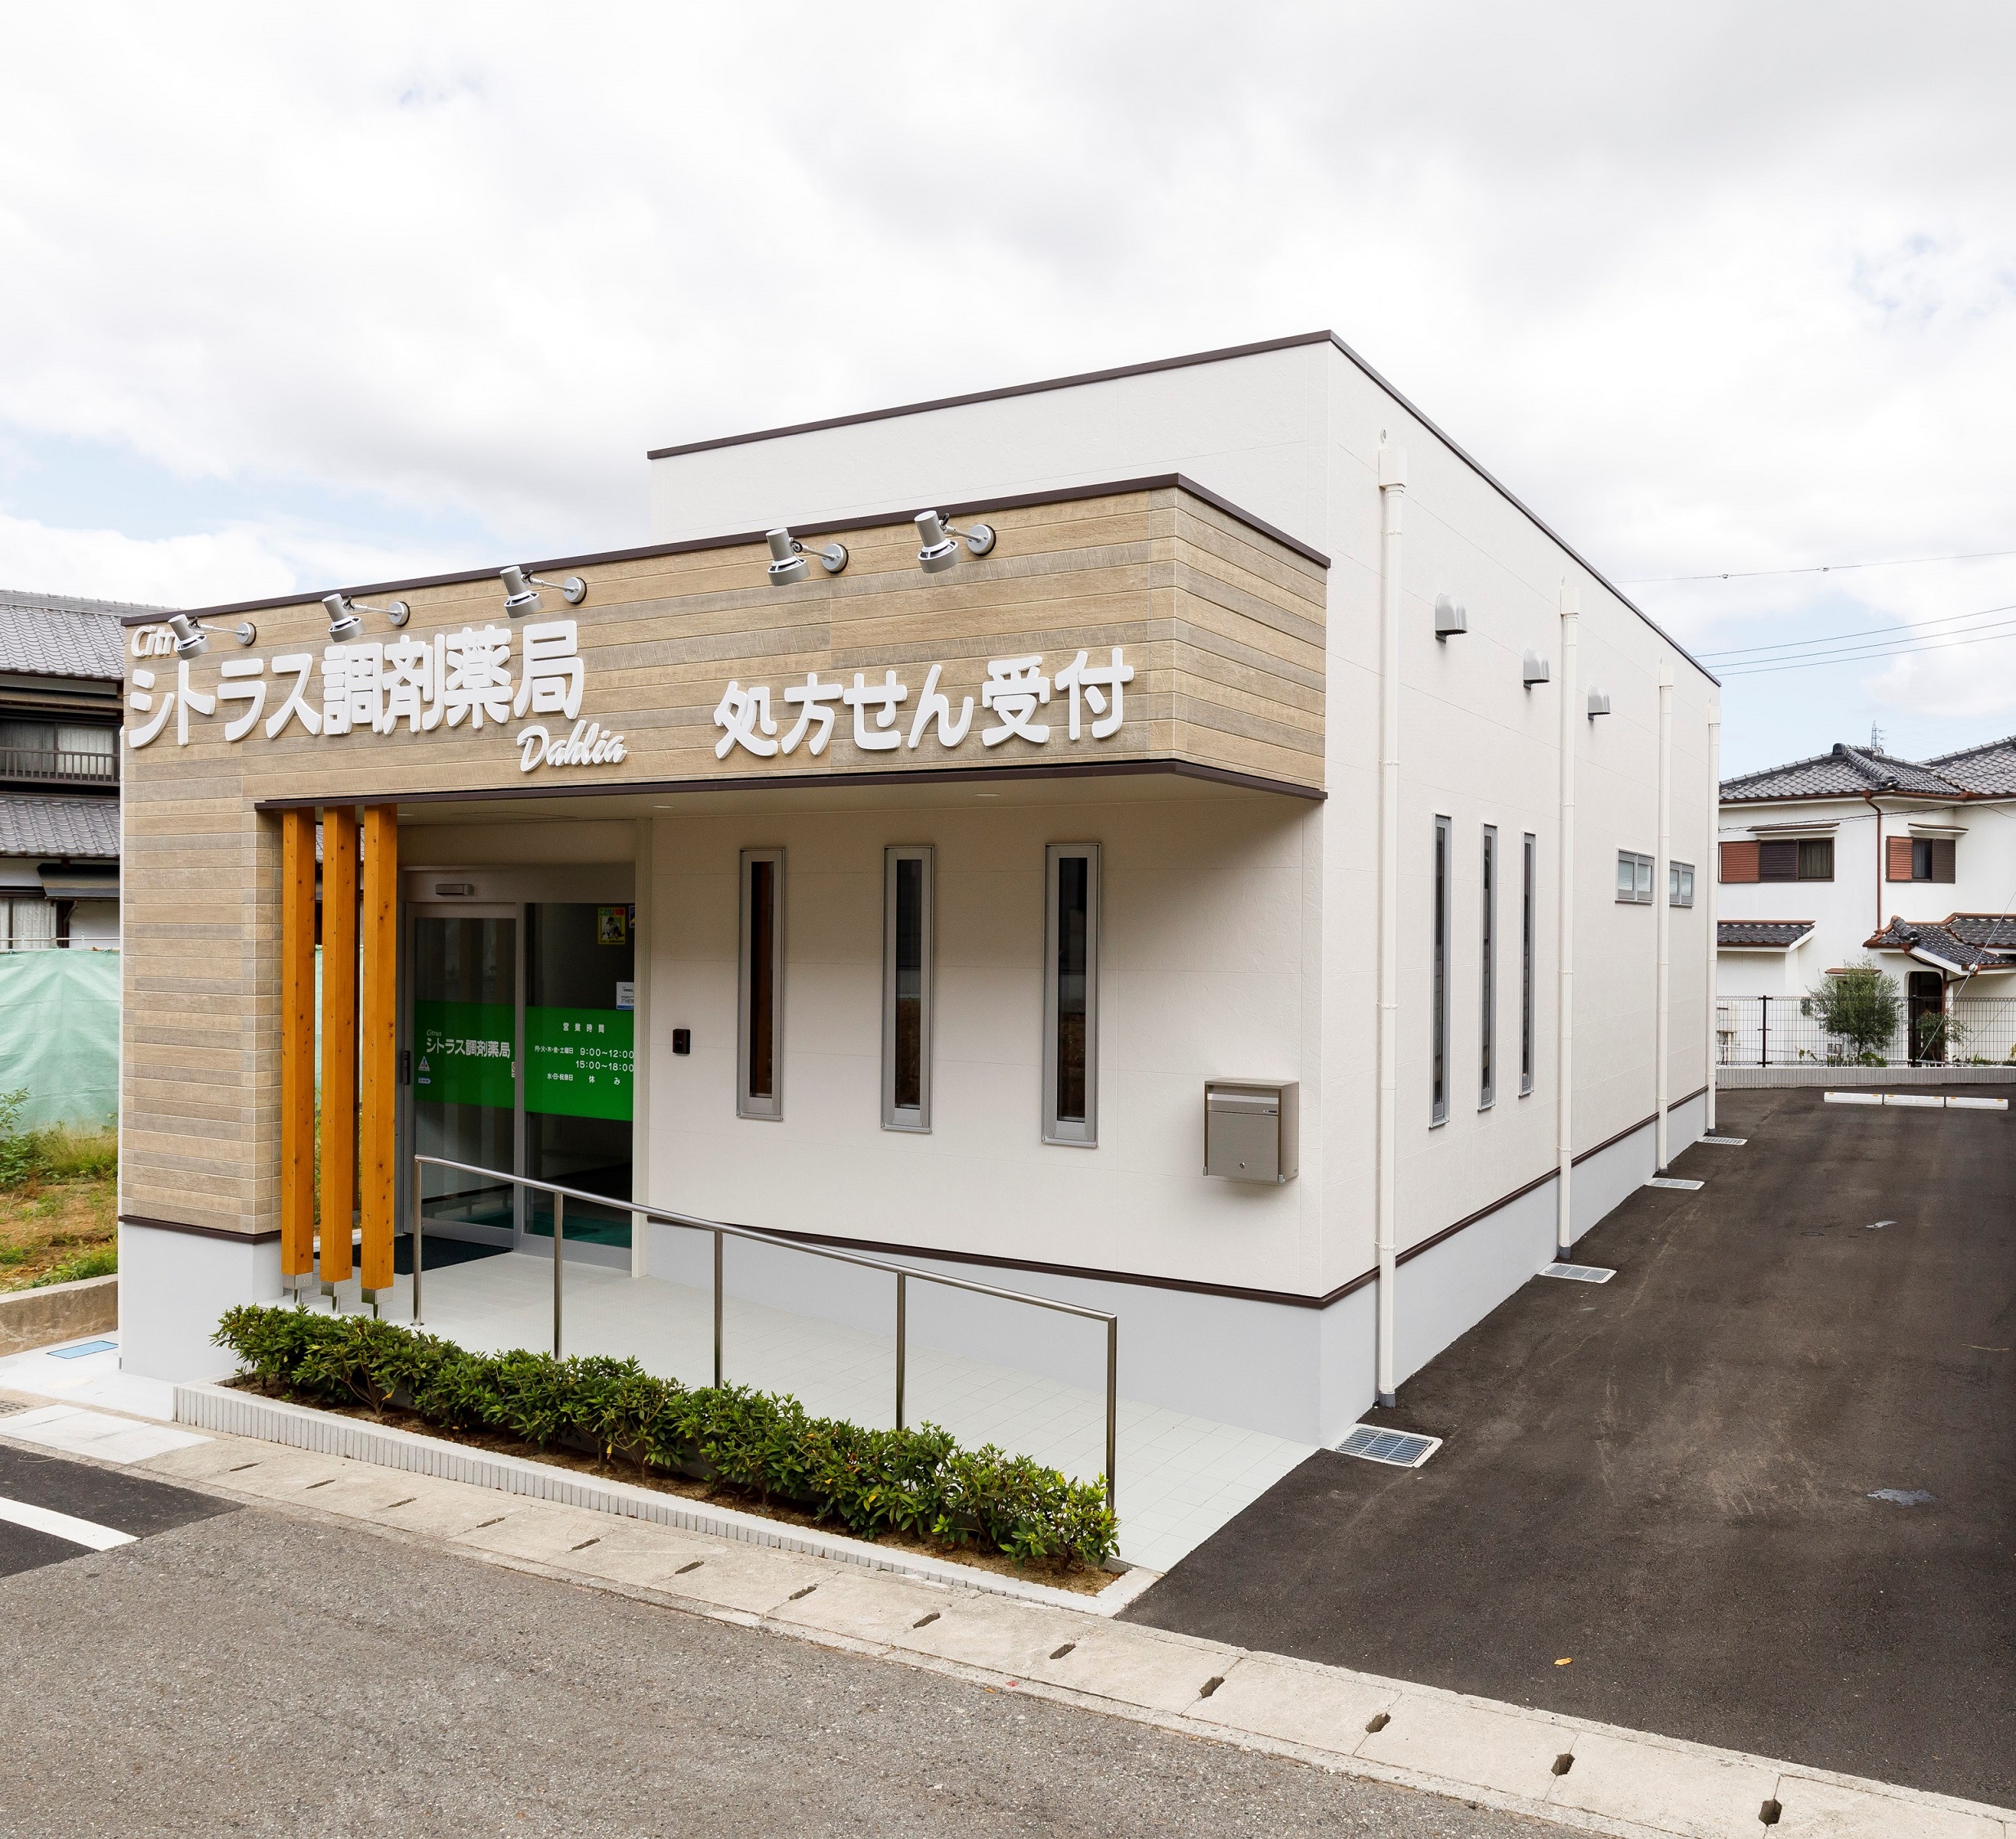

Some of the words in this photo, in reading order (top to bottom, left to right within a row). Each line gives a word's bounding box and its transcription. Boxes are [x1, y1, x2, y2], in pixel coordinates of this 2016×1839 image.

[128, 620, 585, 748] シトラス調剤薬局
[713, 646, 1135, 760] 処方せん受付
[517, 719, 629, 773] Dahlia
[426, 1037, 511, 1059] シトラス調剤薬局
[562, 1021, 605, 1034] 営業時間
